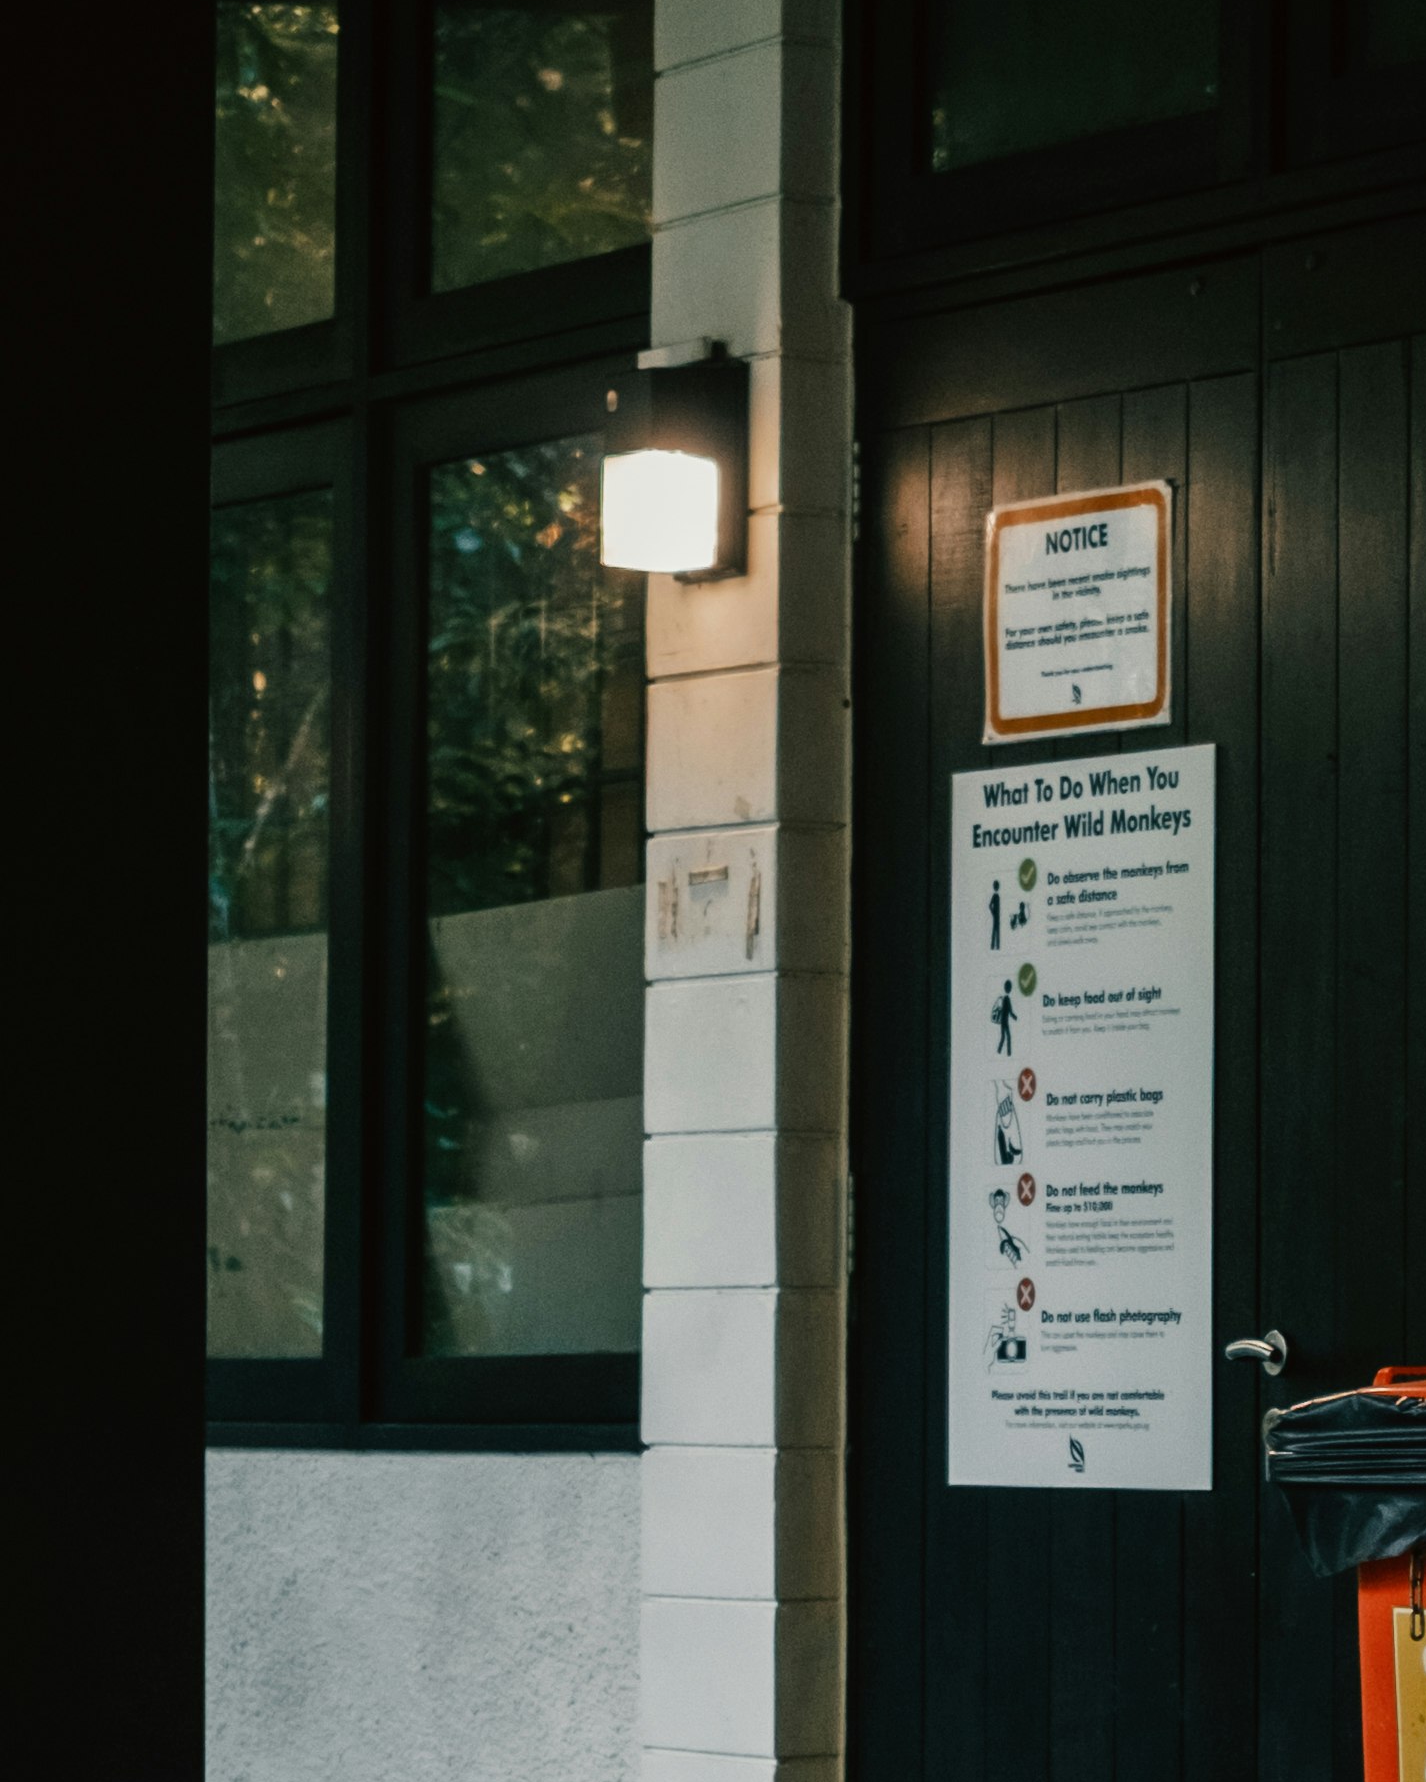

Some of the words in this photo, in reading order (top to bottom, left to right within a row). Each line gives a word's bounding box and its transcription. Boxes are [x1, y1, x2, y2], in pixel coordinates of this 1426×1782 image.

[1046, 523, 1108, 555] NOTICE
[1006, 628, 1017, 638] For
[983, 782, 1029, 808] What
[1034, 779, 1053, 803] To
[1060, 776, 1083, 800] Do
[1089, 769, 1141, 797] When
[1146, 766, 1179, 791] You
[973, 821, 1058, 848] Encounter
[1064, 810, 1104, 839] Wild
[1110, 805, 1191, 836] Monkeys
[1047, 872, 1060, 885] Do
[1063, 870, 1100, 884] observe
[1103, 866, 1118, 880] the
[1121, 862, 1163, 879] monkeys
[1166, 860, 1189, 874] from
[1047, 896, 1053, 906] a
[1056, 890, 1075, 905] safe
[1079, 889, 1118, 903] distance
[1043, 994, 1055, 1007] Do
[1058, 992, 1081, 1008] keep
[1084, 989, 1105, 1004] food
[1108, 991, 1123, 1003] out
[1126, 987, 1135, 1001] of
[1138, 985, 1161, 1003] sight
[1046, 1093, 1058, 1106] Do
[1061, 1093, 1077, 1105] not
[1080, 1093, 1103, 1106] carry
[1107, 1088, 1136, 1107] plastic
[1140, 1087, 1163, 1104] bags
[1046, 1184, 1058, 1197] Do
[1061, 1184, 1077, 1196] not
[1080, 1182, 1100, 1195] feed
[1103, 1181, 1118, 1195] the
[1121, 1180, 1163, 1197] monkeys
[1041, 1310, 1054, 1323] Do
[1057, 1311, 1072, 1323] not
[1075, 1313, 1090, 1323] use
[1093, 1308, 1116, 1322] flash
[1120, 1309, 1181, 1325] photography
[1038, 1390, 1051, 1400] this
[1053, 1390, 1068, 1400] trail
[1070, 1390, 1075, 1400] if
[1077, 1393, 1090, 1403] you
[1092, 1392, 1104, 1400] are
[1107, 1391, 1118, 1400] not
[1031, 1406, 1043, 1416] the
[1079, 1406, 1086, 1416] of
[1088, 1406, 1104, 1416] wild
